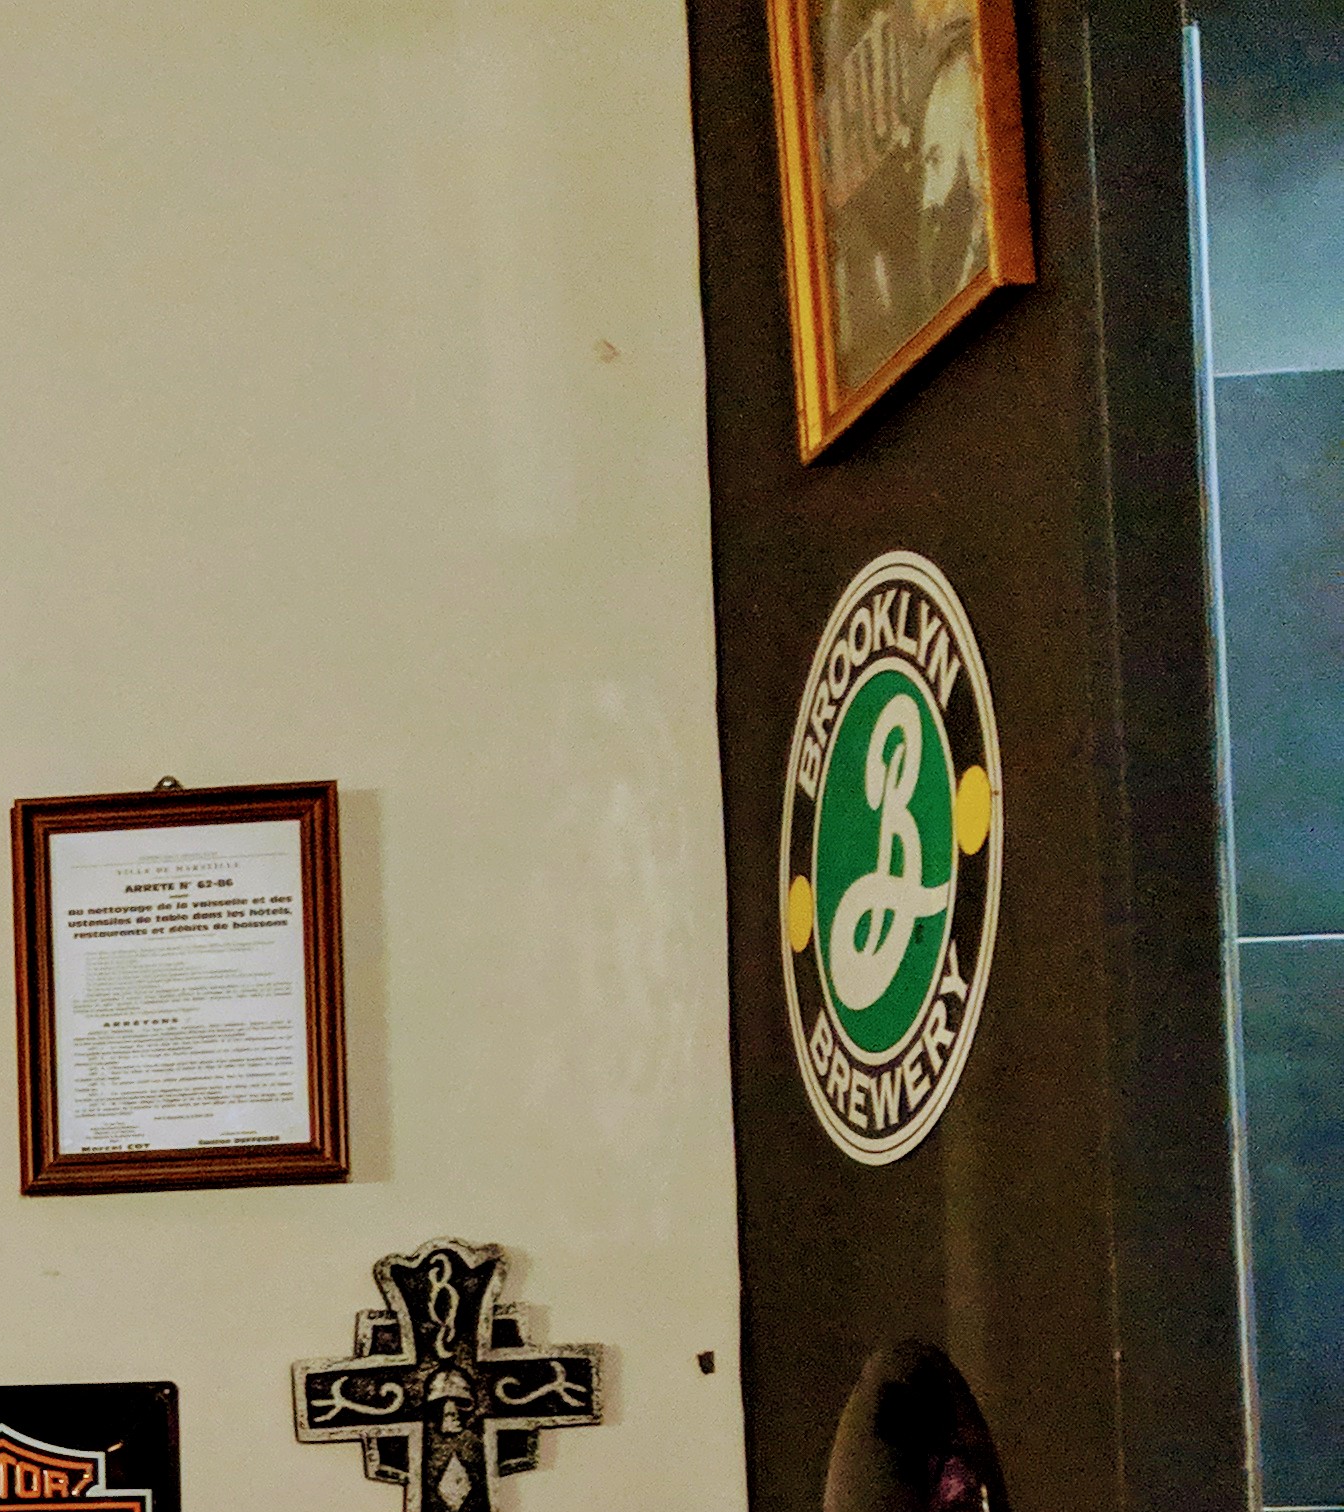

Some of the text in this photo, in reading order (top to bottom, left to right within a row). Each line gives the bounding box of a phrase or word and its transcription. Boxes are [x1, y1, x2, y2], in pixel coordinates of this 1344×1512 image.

[797, 587, 962, 801] BROOKLYN
[88, 905, 153, 915] nettoyage
[157, 902, 172, 910] de
[68, 917, 131, 928] ustensiles
[136, 916, 151, 924] de
[156, 913, 188, 923] table
[193, 911, 222, 920] dans
[74, 928, 147, 939] restaurants
[152, 927, 164, 935] et
[213, 922, 228, 931] de
[812, 938, 971, 1130] BREWERY
